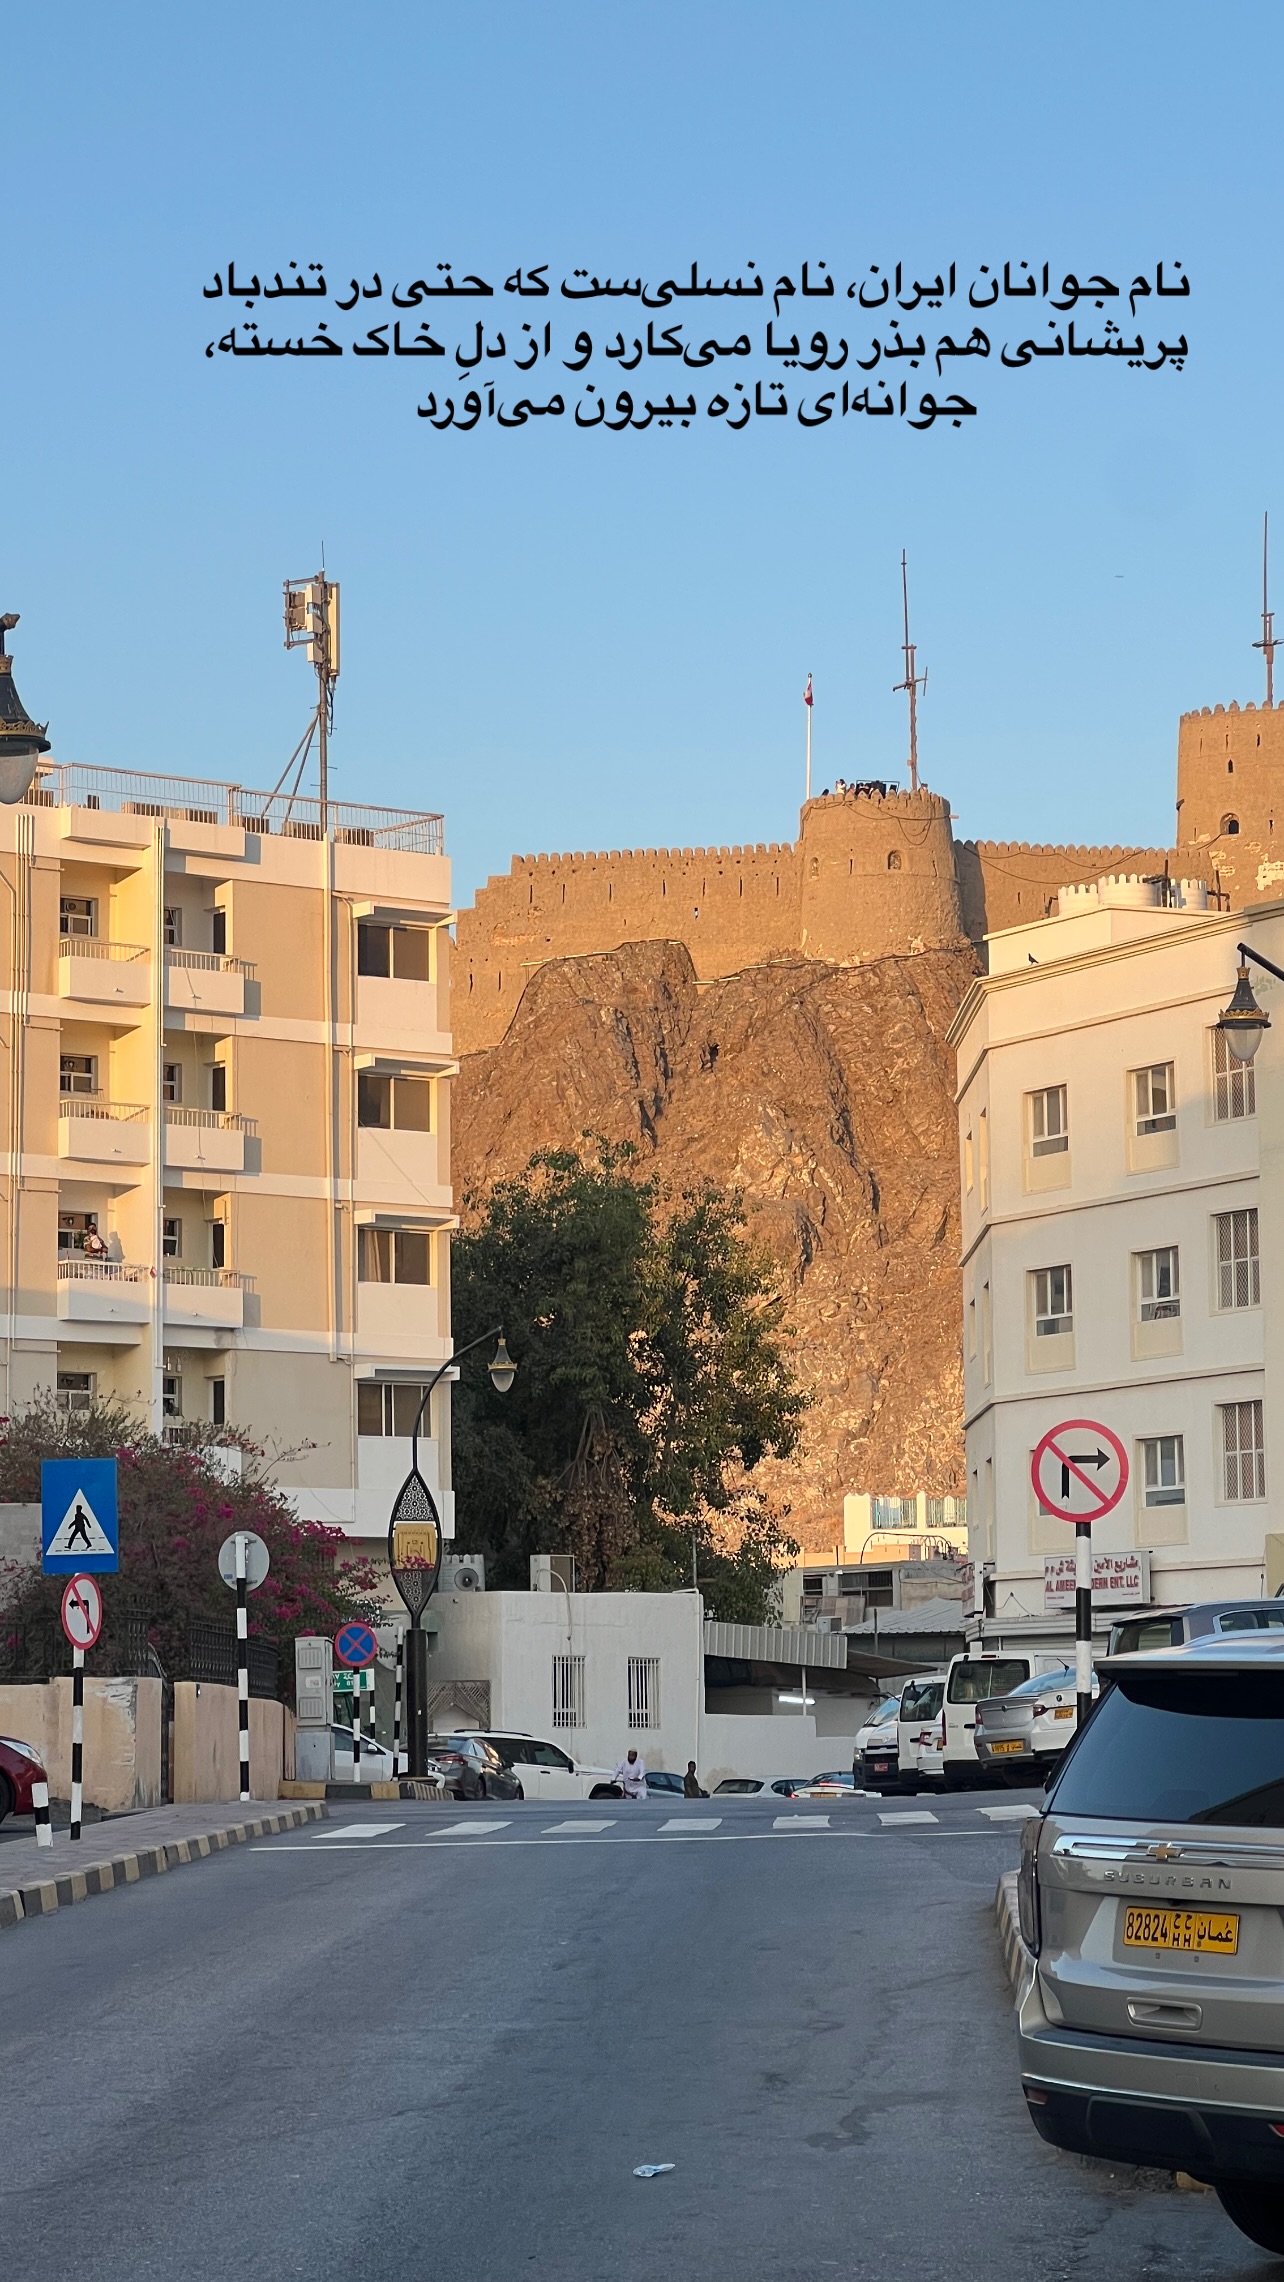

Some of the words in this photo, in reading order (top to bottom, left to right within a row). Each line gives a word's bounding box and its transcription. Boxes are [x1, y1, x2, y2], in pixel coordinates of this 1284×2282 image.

[1056, 1579, 1076, 1592] AMEE
[1126, 1575, 1139, 1588] LLC
[1103, 1870, 1231, 1889] SUBURBAN
[1126, 1911, 1168, 1943] 82824
